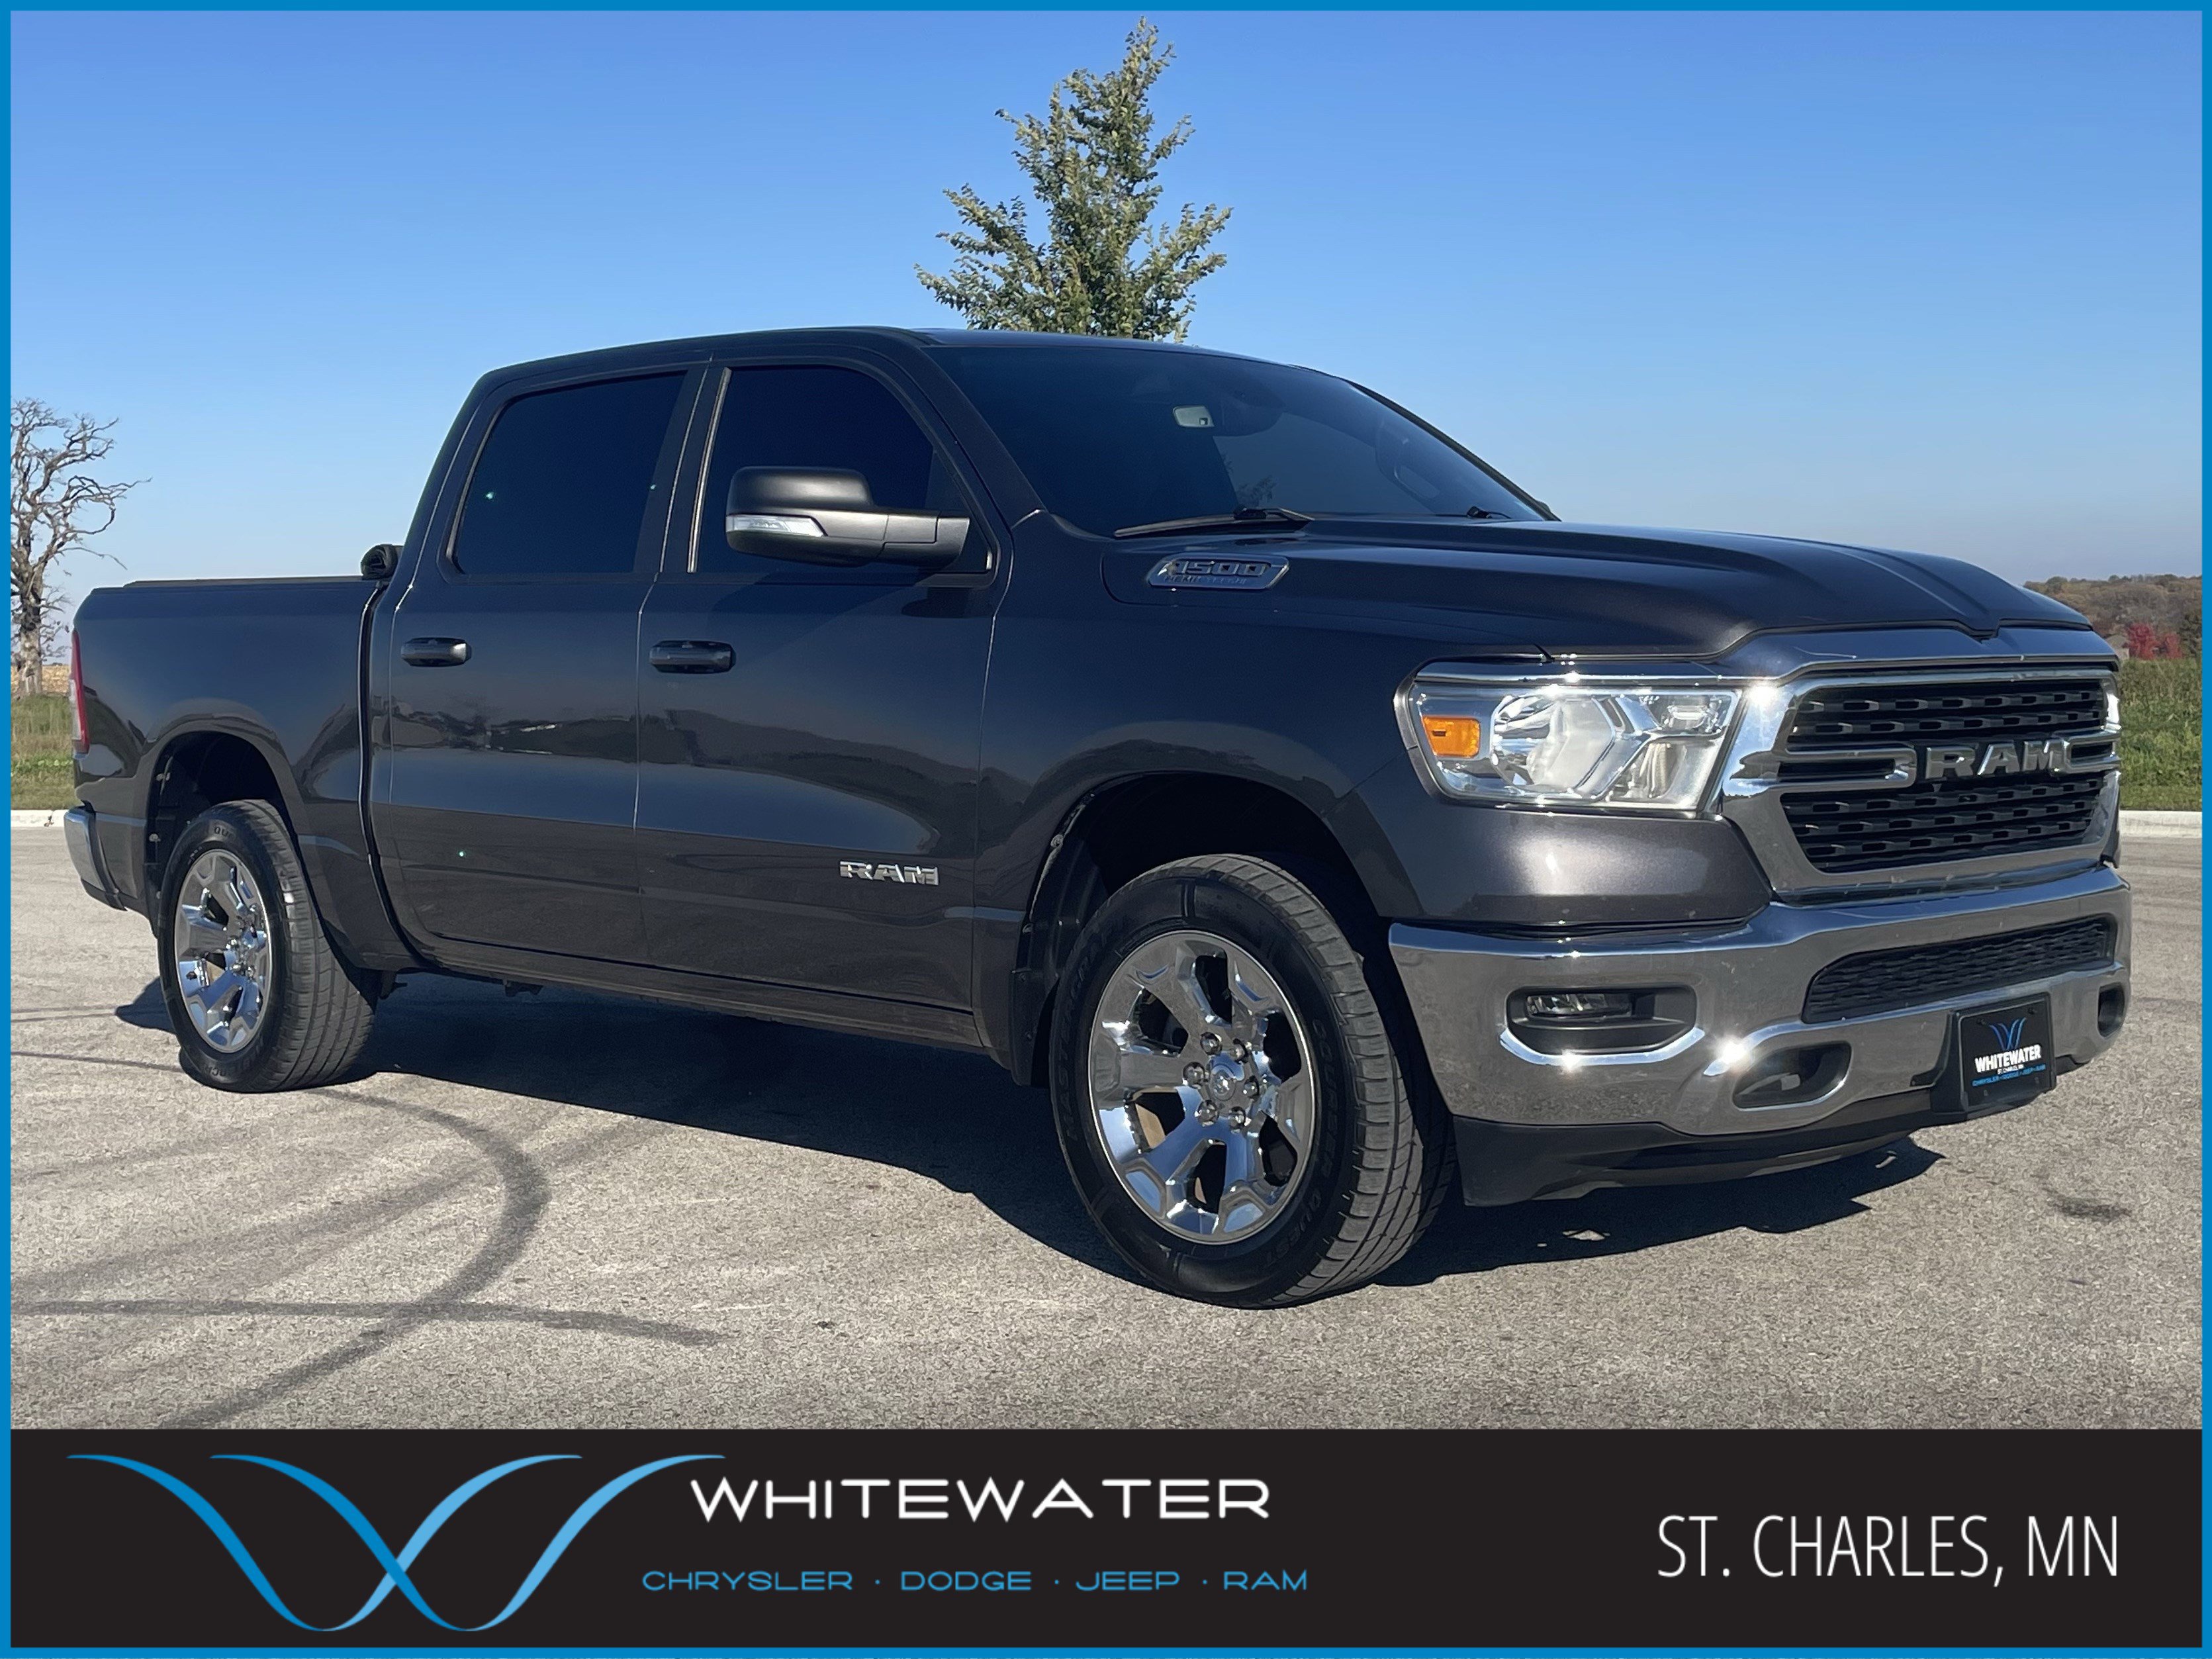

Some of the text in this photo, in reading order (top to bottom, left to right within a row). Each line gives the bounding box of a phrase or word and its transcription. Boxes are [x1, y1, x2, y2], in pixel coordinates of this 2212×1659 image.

[1169, 561, 1266, 577] 1500
[1925, 737, 2062, 780] RAM
[840, 861, 939, 886] RAM
[1974, 1044, 2042, 1072] WHITEWATER
